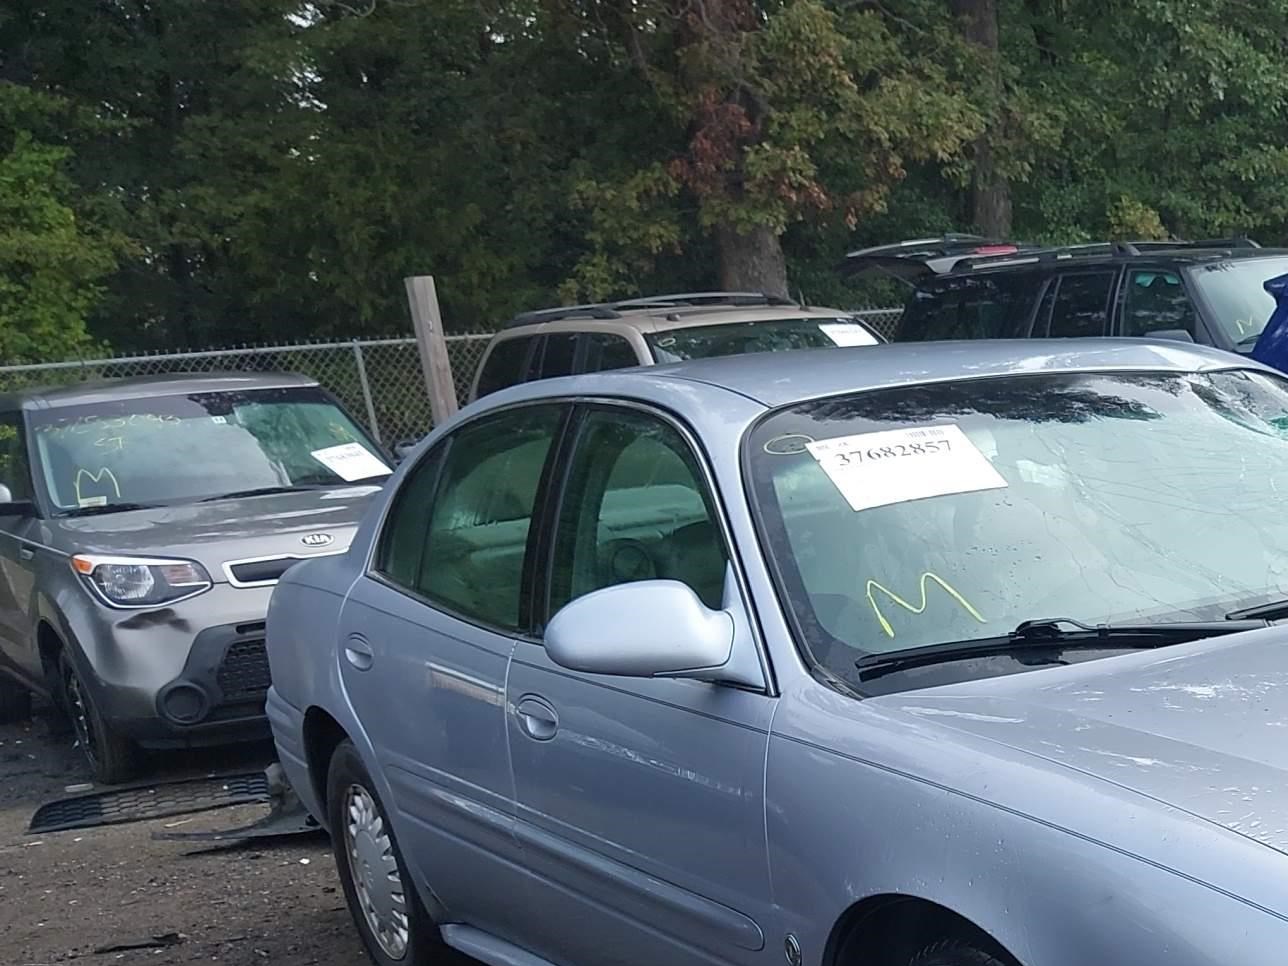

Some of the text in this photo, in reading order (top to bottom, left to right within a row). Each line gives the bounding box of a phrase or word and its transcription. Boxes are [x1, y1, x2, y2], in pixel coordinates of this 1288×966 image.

[834, 440, 951, 466] 37682857
[73, 467, 121, 502] M
[866, 572, 987, 638] M
